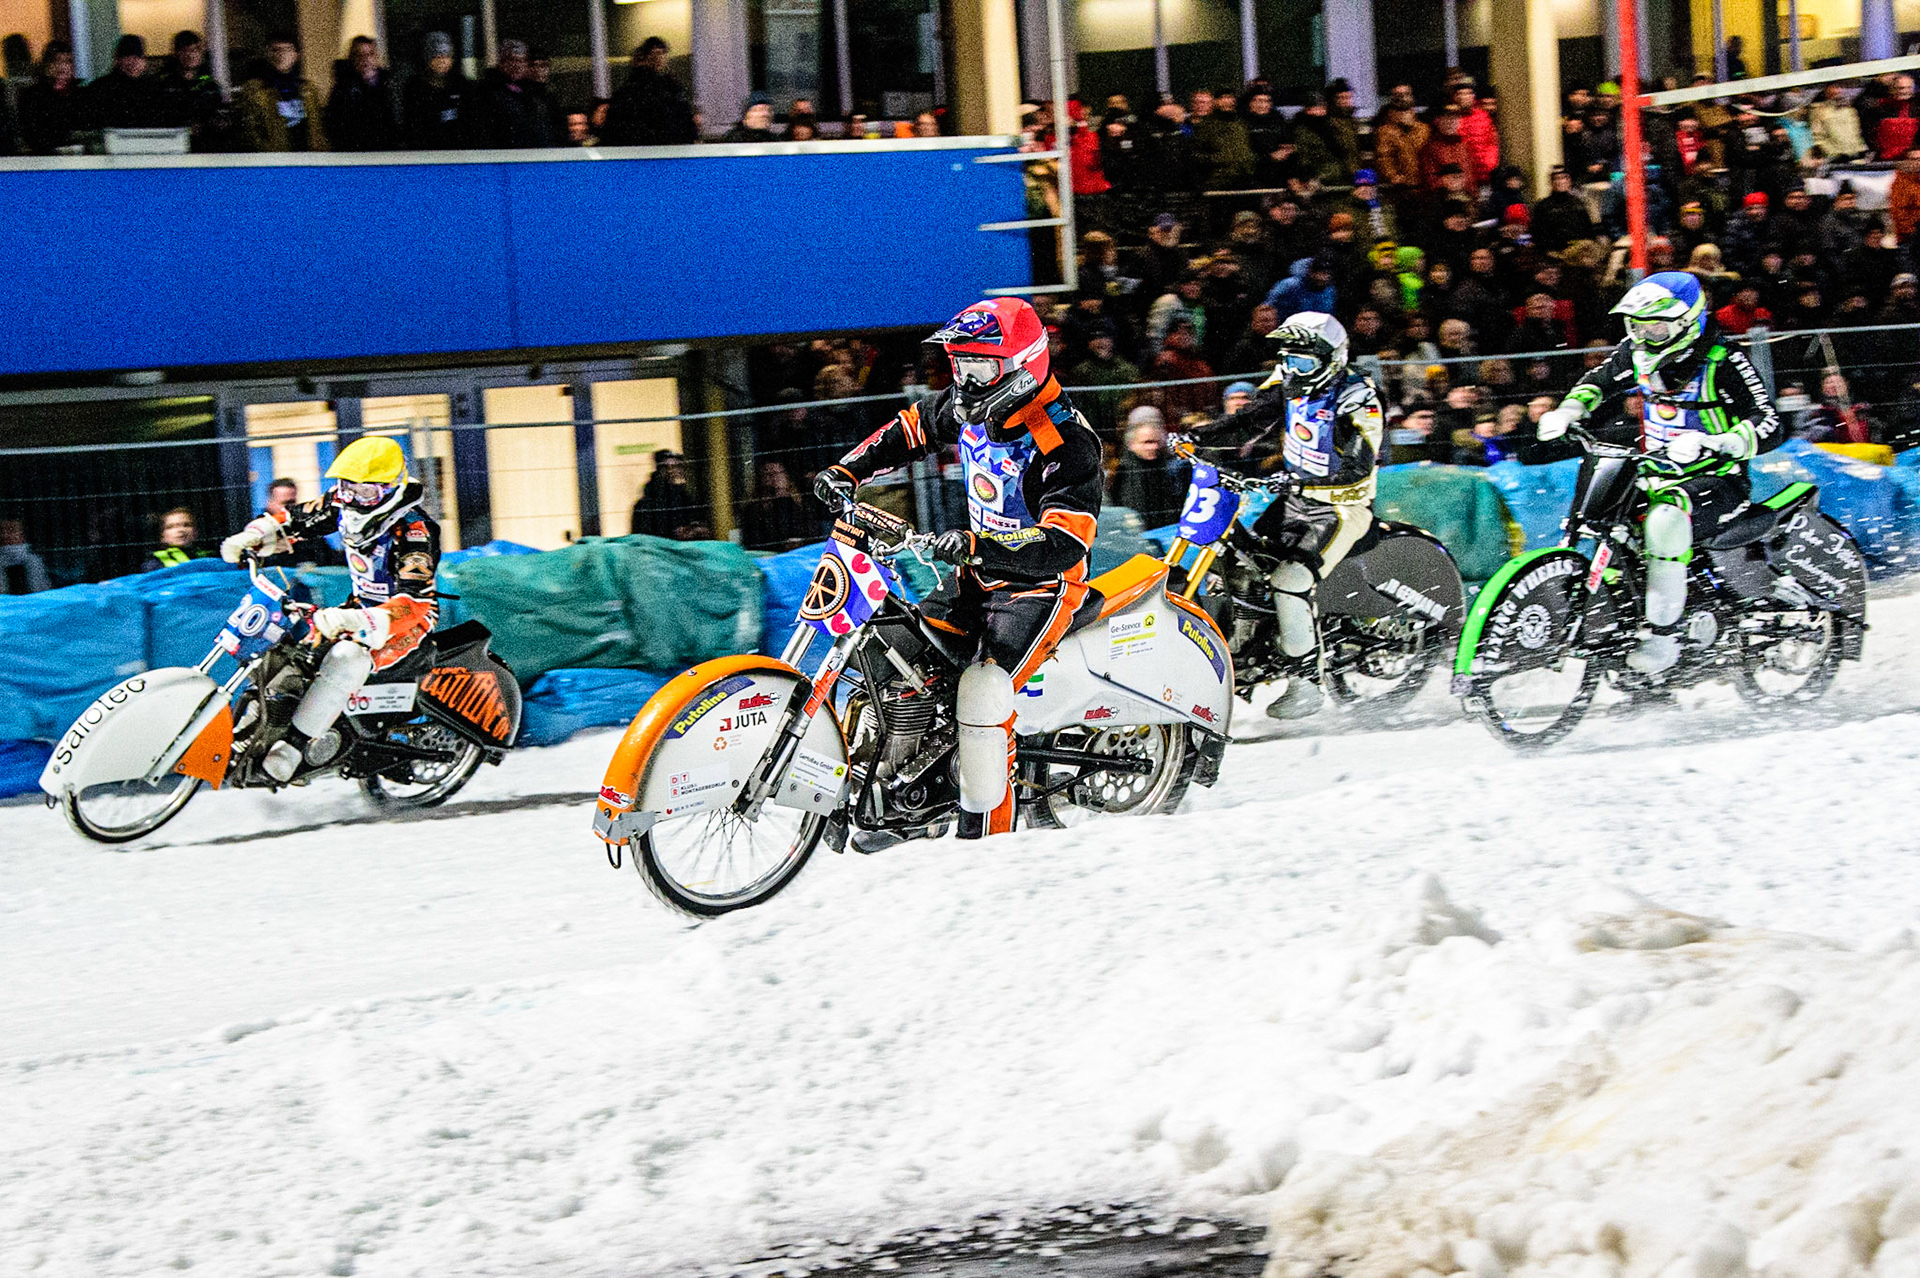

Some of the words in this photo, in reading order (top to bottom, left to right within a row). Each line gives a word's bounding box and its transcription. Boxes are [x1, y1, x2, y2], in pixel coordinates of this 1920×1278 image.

[1182, 619, 1215, 660] Putoline
[673, 690, 728, 735] Putoline
[734, 710, 768, 730] JUTA
